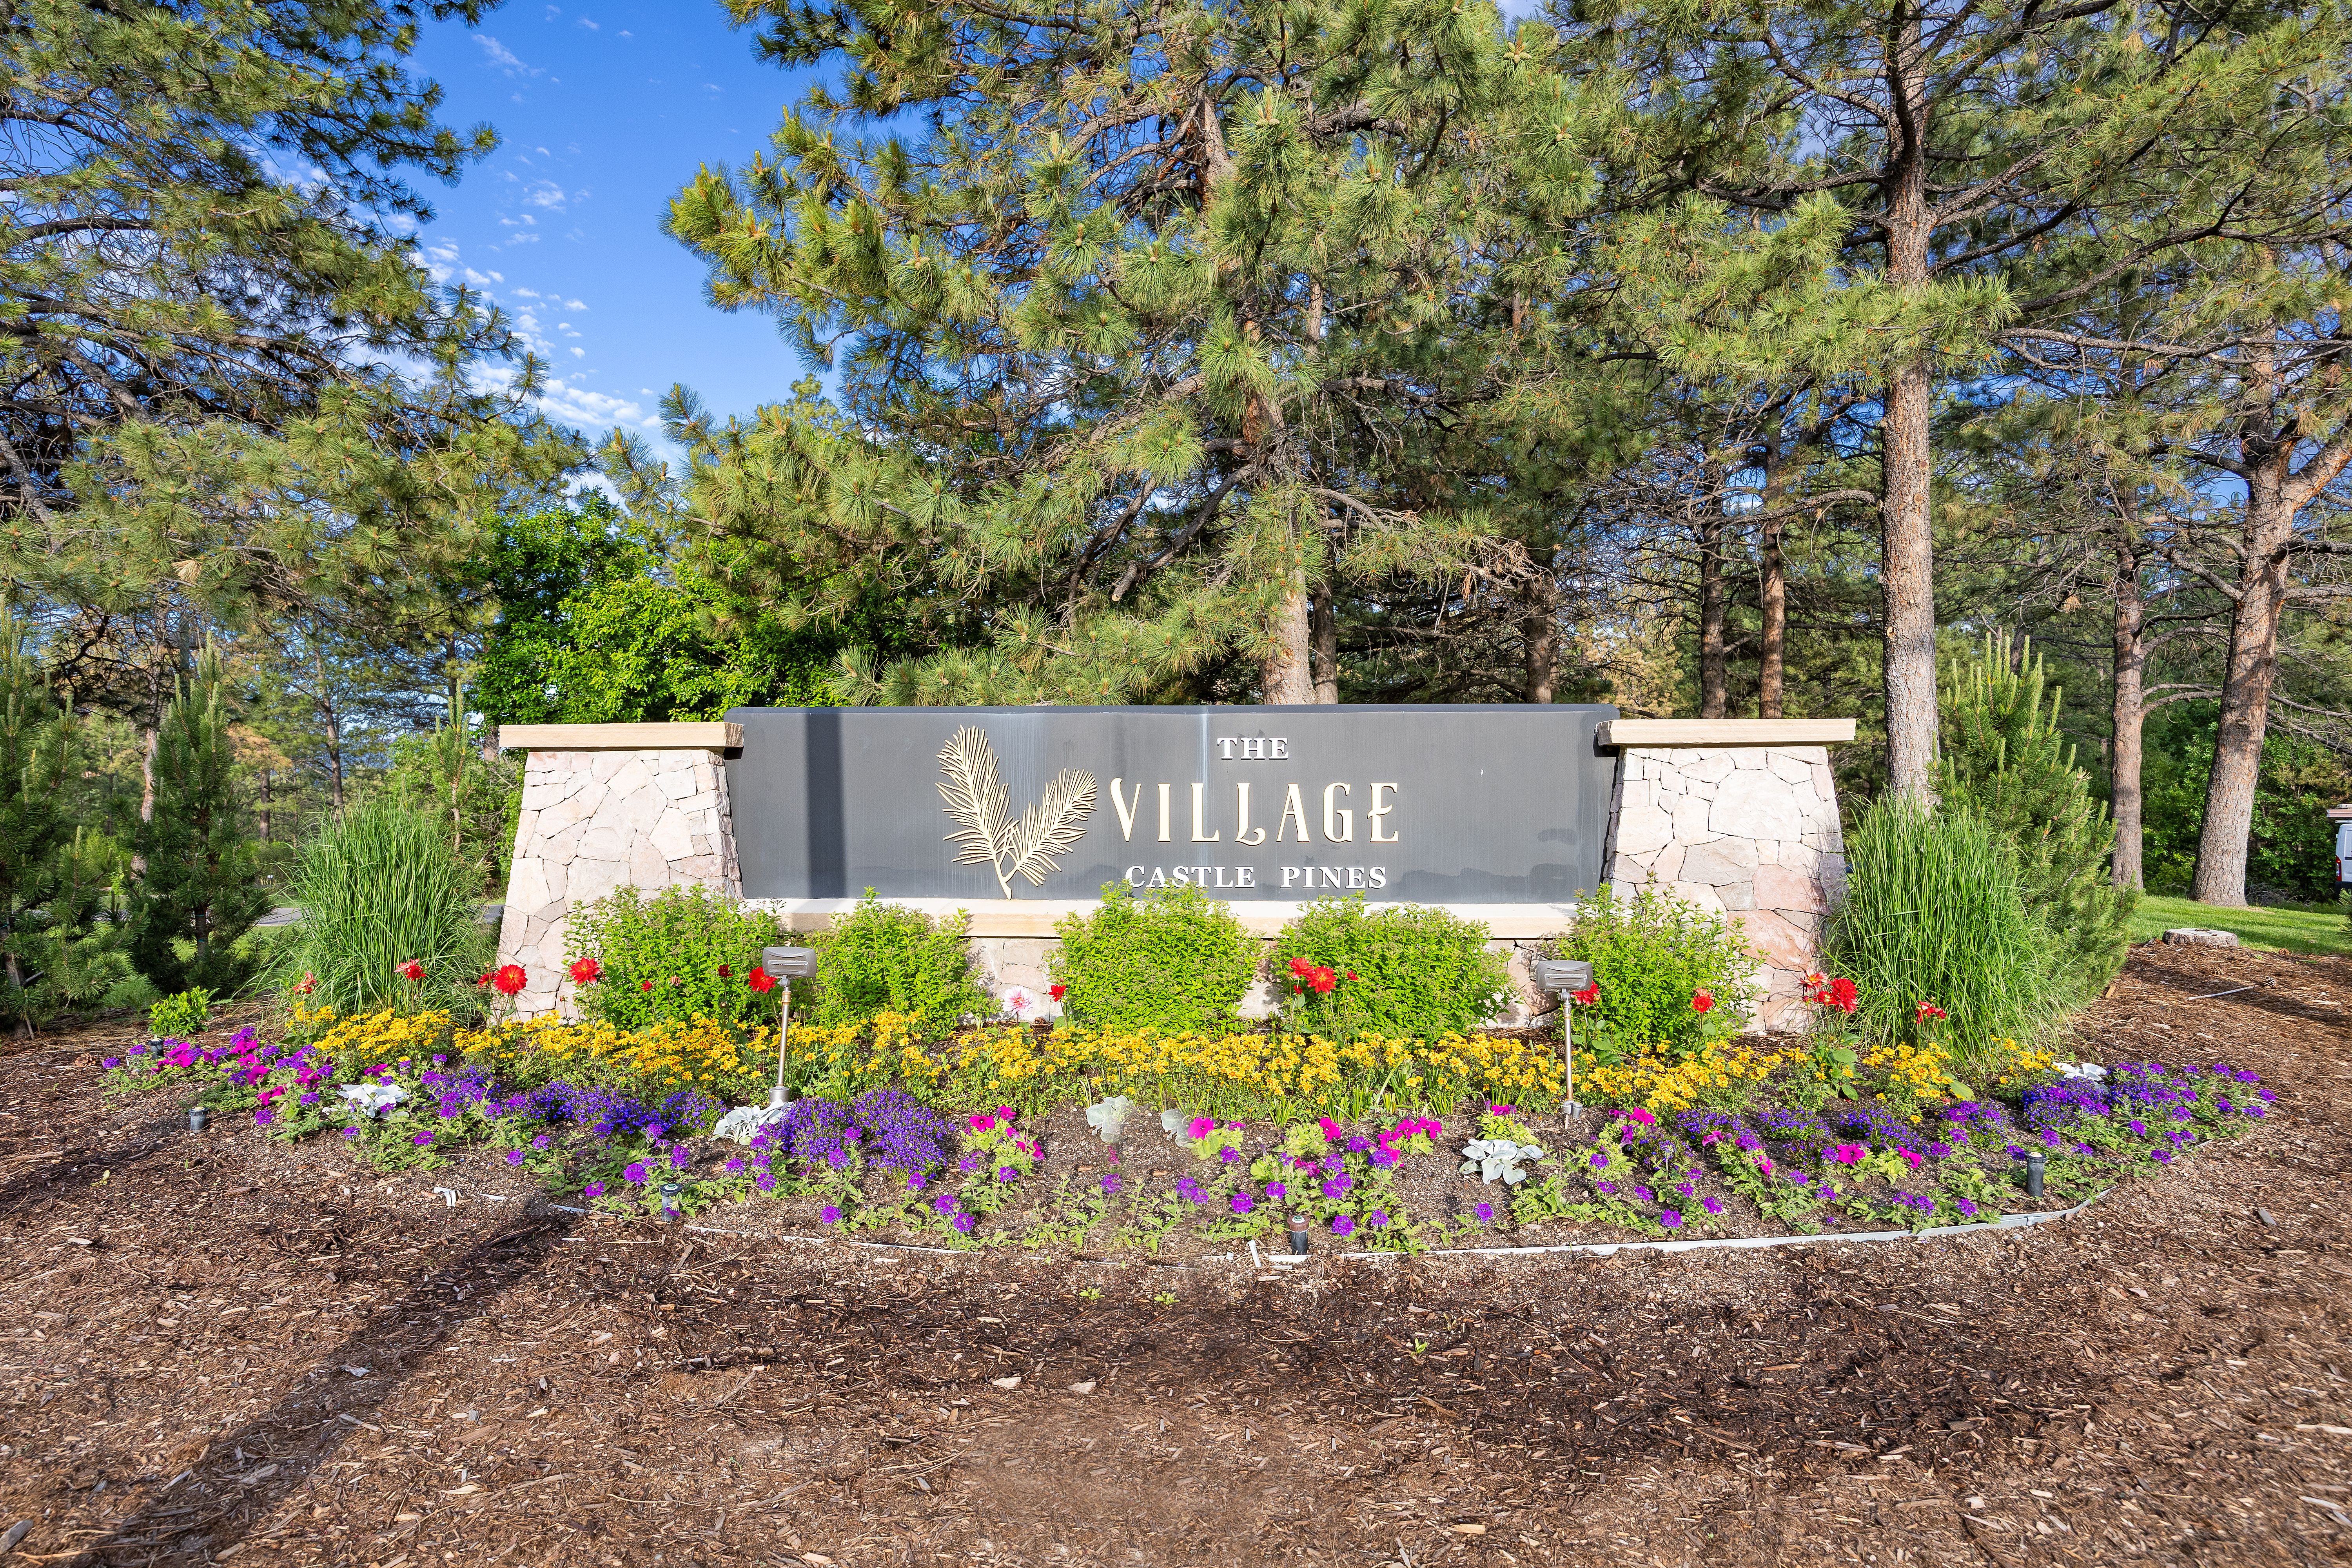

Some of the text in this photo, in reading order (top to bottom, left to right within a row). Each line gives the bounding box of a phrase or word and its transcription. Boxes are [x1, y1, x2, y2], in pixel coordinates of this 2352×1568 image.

[1217, 737, 1289, 760] THE
[1110, 778, 1399, 846] VILLAGE
[1125, 866, 1387, 889] CASTLE PINES
